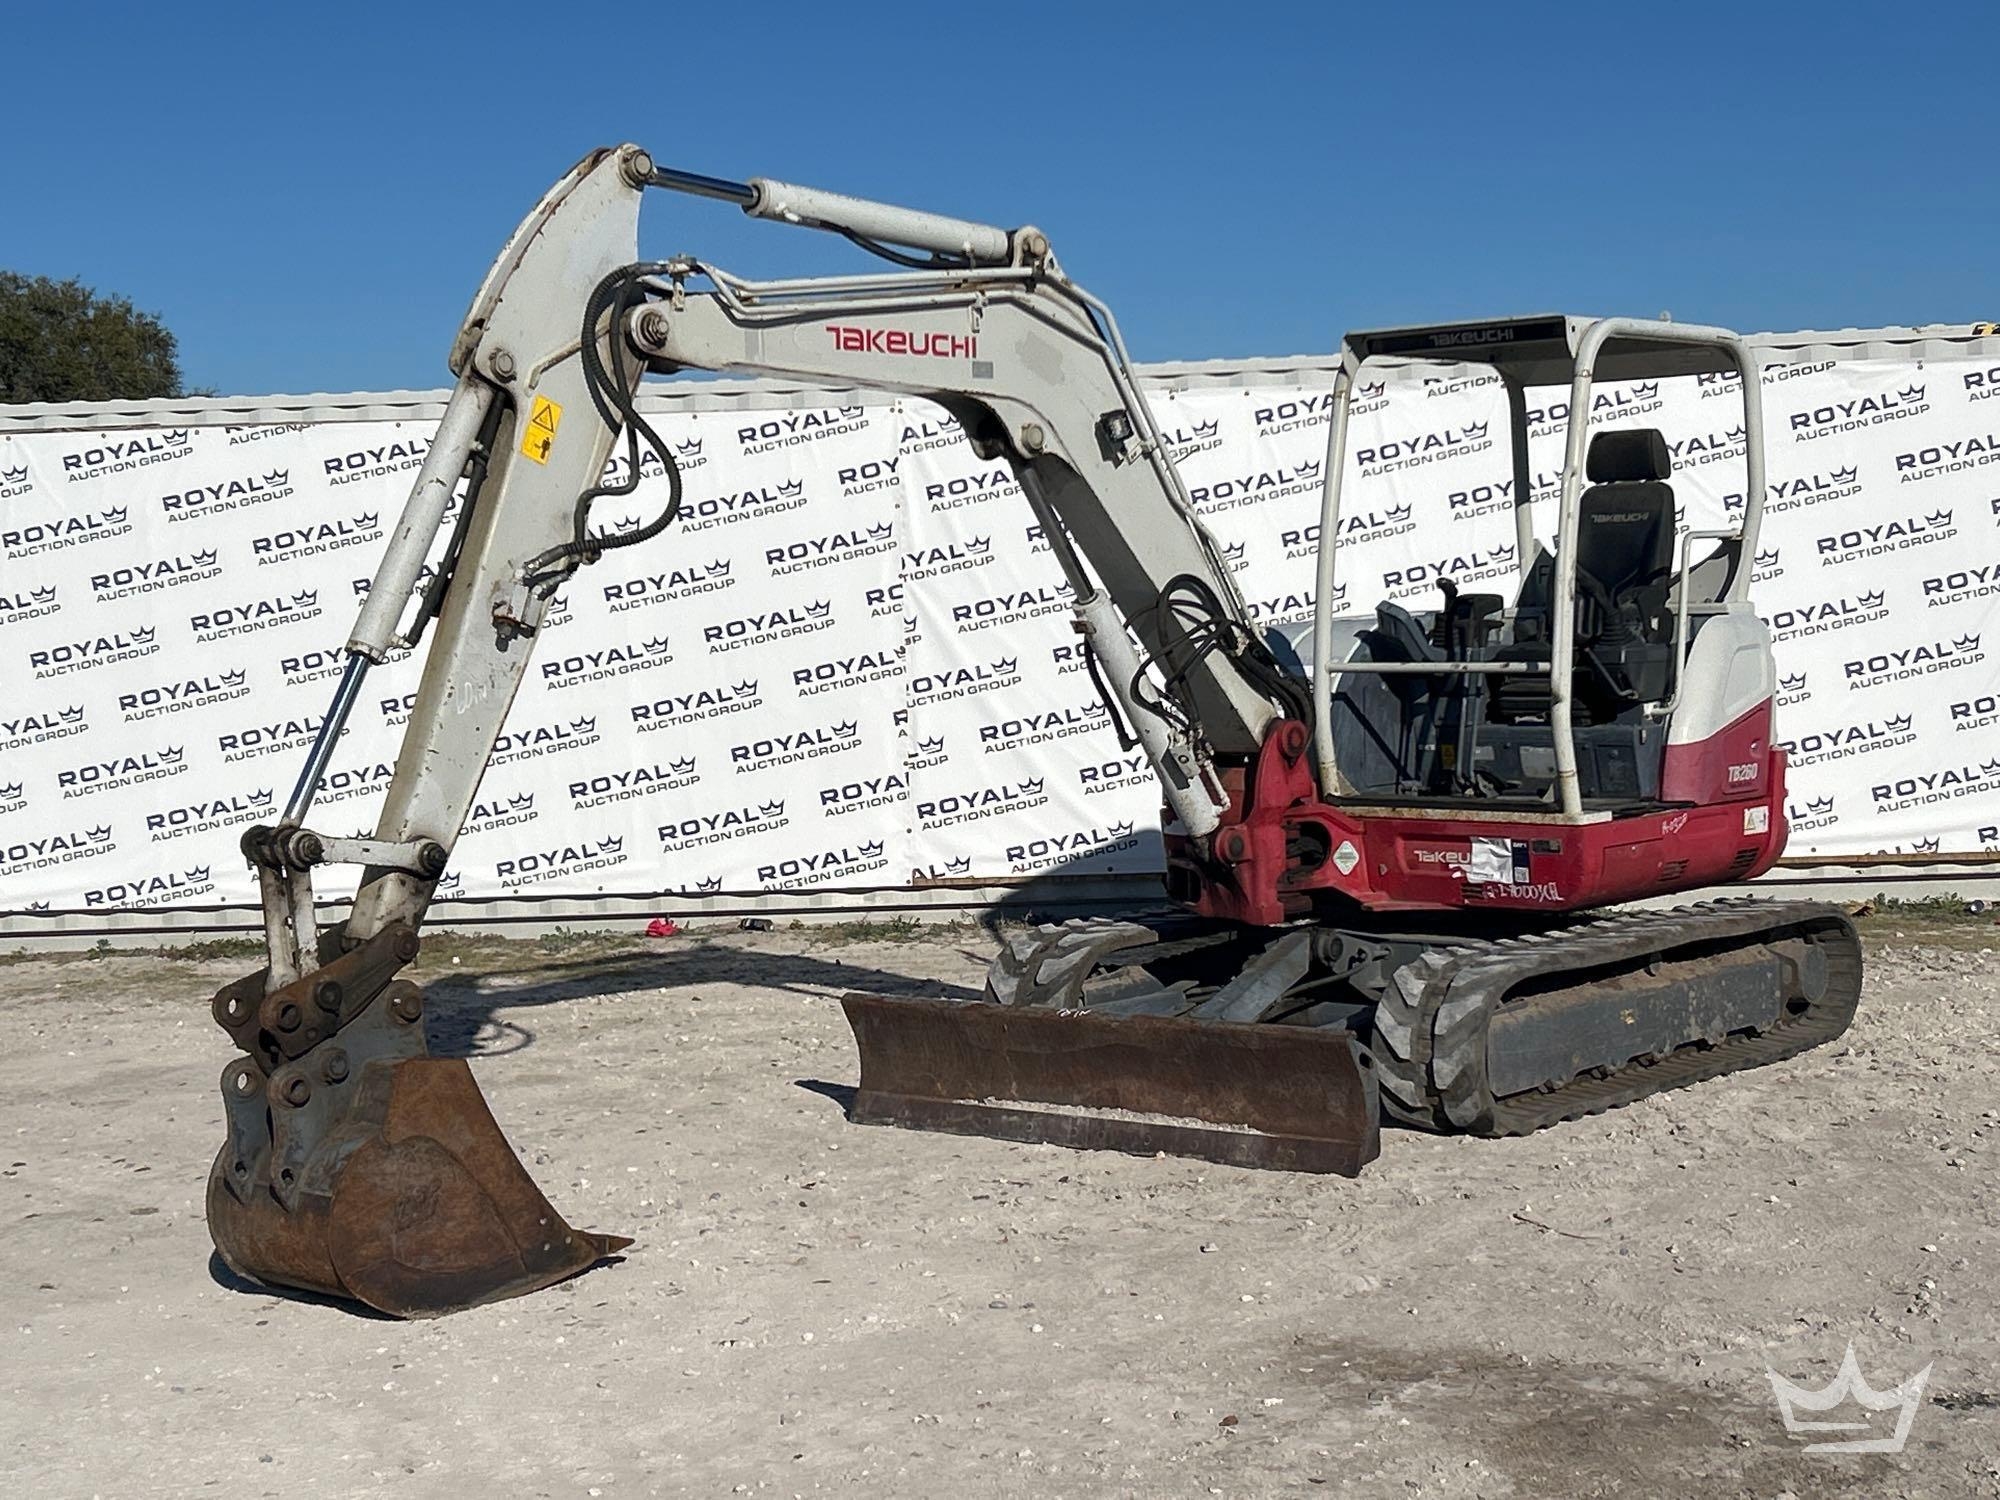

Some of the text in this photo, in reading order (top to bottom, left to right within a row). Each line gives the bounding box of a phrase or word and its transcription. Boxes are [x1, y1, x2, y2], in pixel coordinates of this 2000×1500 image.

[1427, 376, 1499, 398] AUCTION
[1778, 361, 1836, 381] GROUP
[737, 410, 839, 444] ROYAL
[1259, 414, 1330, 437] AUCTION
[1606, 401, 1663, 421] GROUP
[1790, 393, 1899, 430] ROYAL
[1796, 404, 1930, 443] AUCTION GROUP
[62, 437, 164, 471] ROYAL
[744, 420, 869, 456] AUCTION GROUP
[1356, 430, 1462, 466] ROYAL
[68, 447, 193, 483] AUCTION GROUP
[324, 440, 426, 475] ROYAL
[1362, 440, 1492, 478] AUCTION GROUP
[1901, 459, 1974, 484] AUCTION
[330, 464, 398, 486] AUCTION
[1190, 469, 1294, 505] ROYAL
[162, 477, 264, 512] ROYAL
[168, 488, 294, 523] AUCTION GROUP
[678, 488, 778, 521] ROYAL
[931, 490, 1000, 513] AUCTION
[1196, 480, 1325, 516] AUCTION GROUP
[1804, 485, 1862, 505] GROUP
[1, 514, 103, 548] ROYAL
[682, 498, 807, 534] AUCTION GROUP
[1360, 523, 1416, 542] GROUP
[8, 524, 132, 560] AUCTION GROUP
[252, 521, 354, 554] ROYAL
[258, 531, 383, 566] AUCTION GROUP
[765, 531, 868, 565] ROYAL
[1817, 518, 1926, 554] ROYAL
[1822, 529, 1958, 567] AUCTION GROUP
[90, 557, 193, 591] ROYAL
[771, 541, 897, 577] AUCTION GROUP
[940, 554, 995, 574] GROUP
[1383, 553, 1488, 589] ROYAL
[1463, 563, 1520, 584] GROUP
[96, 567, 222, 603] AUCTION GROUP
[603, 568, 706, 602] ROYAL
[609, 578, 735, 613] AUCTION GROUP
[7, 604, 61, 623] GROUP
[190, 598, 293, 631] ROYAL
[952, 588, 1055, 622] ROYAL
[1831, 609, 1889, 629] GROUP
[196, 608, 322, 643] AUCTION GROUP
[703, 608, 806, 643] ROYAL
[709, 619, 835, 655] AUCTION GROUP
[958, 611, 1027, 634] AUCTION
[29, 634, 131, 668] ROYAL
[35, 644, 160, 680] AUCTION GROUP
[541, 645, 644, 679] ROYAL
[793, 651, 895, 685] ROYAL
[1843, 642, 1953, 679] ROYAL
[547, 655, 673, 691] AUCTION GROUP
[798, 674, 867, 697] AUCTION
[967, 676, 1022, 695] GROUP
[1850, 653, 1985, 691] AUCTION GROUP
[118, 677, 221, 711] ROYAL
[124, 687, 250, 723] AUCTION GROUP
[631, 688, 733, 722] ROYAL
[637, 698, 763, 734] AUCTION GROUP
[979, 709, 1082, 742] ROYAL
[35, 724, 89, 743] GROUP
[219, 717, 320, 752] ROYAL
[546, 735, 600, 754] GROUP
[731, 729, 833, 763] ROYAL
[985, 719, 1111, 754] AUCTION GROUP
[1859, 733, 1917, 753] GROUP
[225, 741, 293, 763] AUCTION
[736, 739, 862, 774] AUCTION GROUP
[58, 754, 159, 788] ROYAL
[63, 764, 188, 800] AUCTION GROUP
[568, 765, 671, 799] ROYAL
[1084, 773, 1154, 795] AUCTION
[1871, 766, 1981, 802] ROYAL
[314, 784, 382, 806] AUCTION
[574, 775, 700, 811] AUCTION GROUP
[825, 794, 894, 817] AUCTION
[916, 786, 1019, 819] ROYAL
[1877, 791, 1950, 814] AUCTION
[146, 797, 248, 831] ROYAL
[152, 807, 277, 842] AUCTION GROUP
[484, 811, 538, 830] GROUP
[658, 808, 760, 842] ROYAL
[922, 796, 1048, 831] AUCTION GROUP
[663, 818, 789, 853] AUCTION GROUP
[1006, 829, 1109, 862] ROYAL
[0, 843, 116, 876] UCTION GROUP
[496, 844, 598, 877] ROYAL
[501, 854, 628, 889] AUCTION GROUP
[757, 848, 859, 882] ROYAL
[834, 859, 888, 878] GROUP
[1011, 839, 1138, 874] AUCTION GROUP
[84, 873, 186, 907] ROYAL
[161, 884, 215, 902] GROUP
